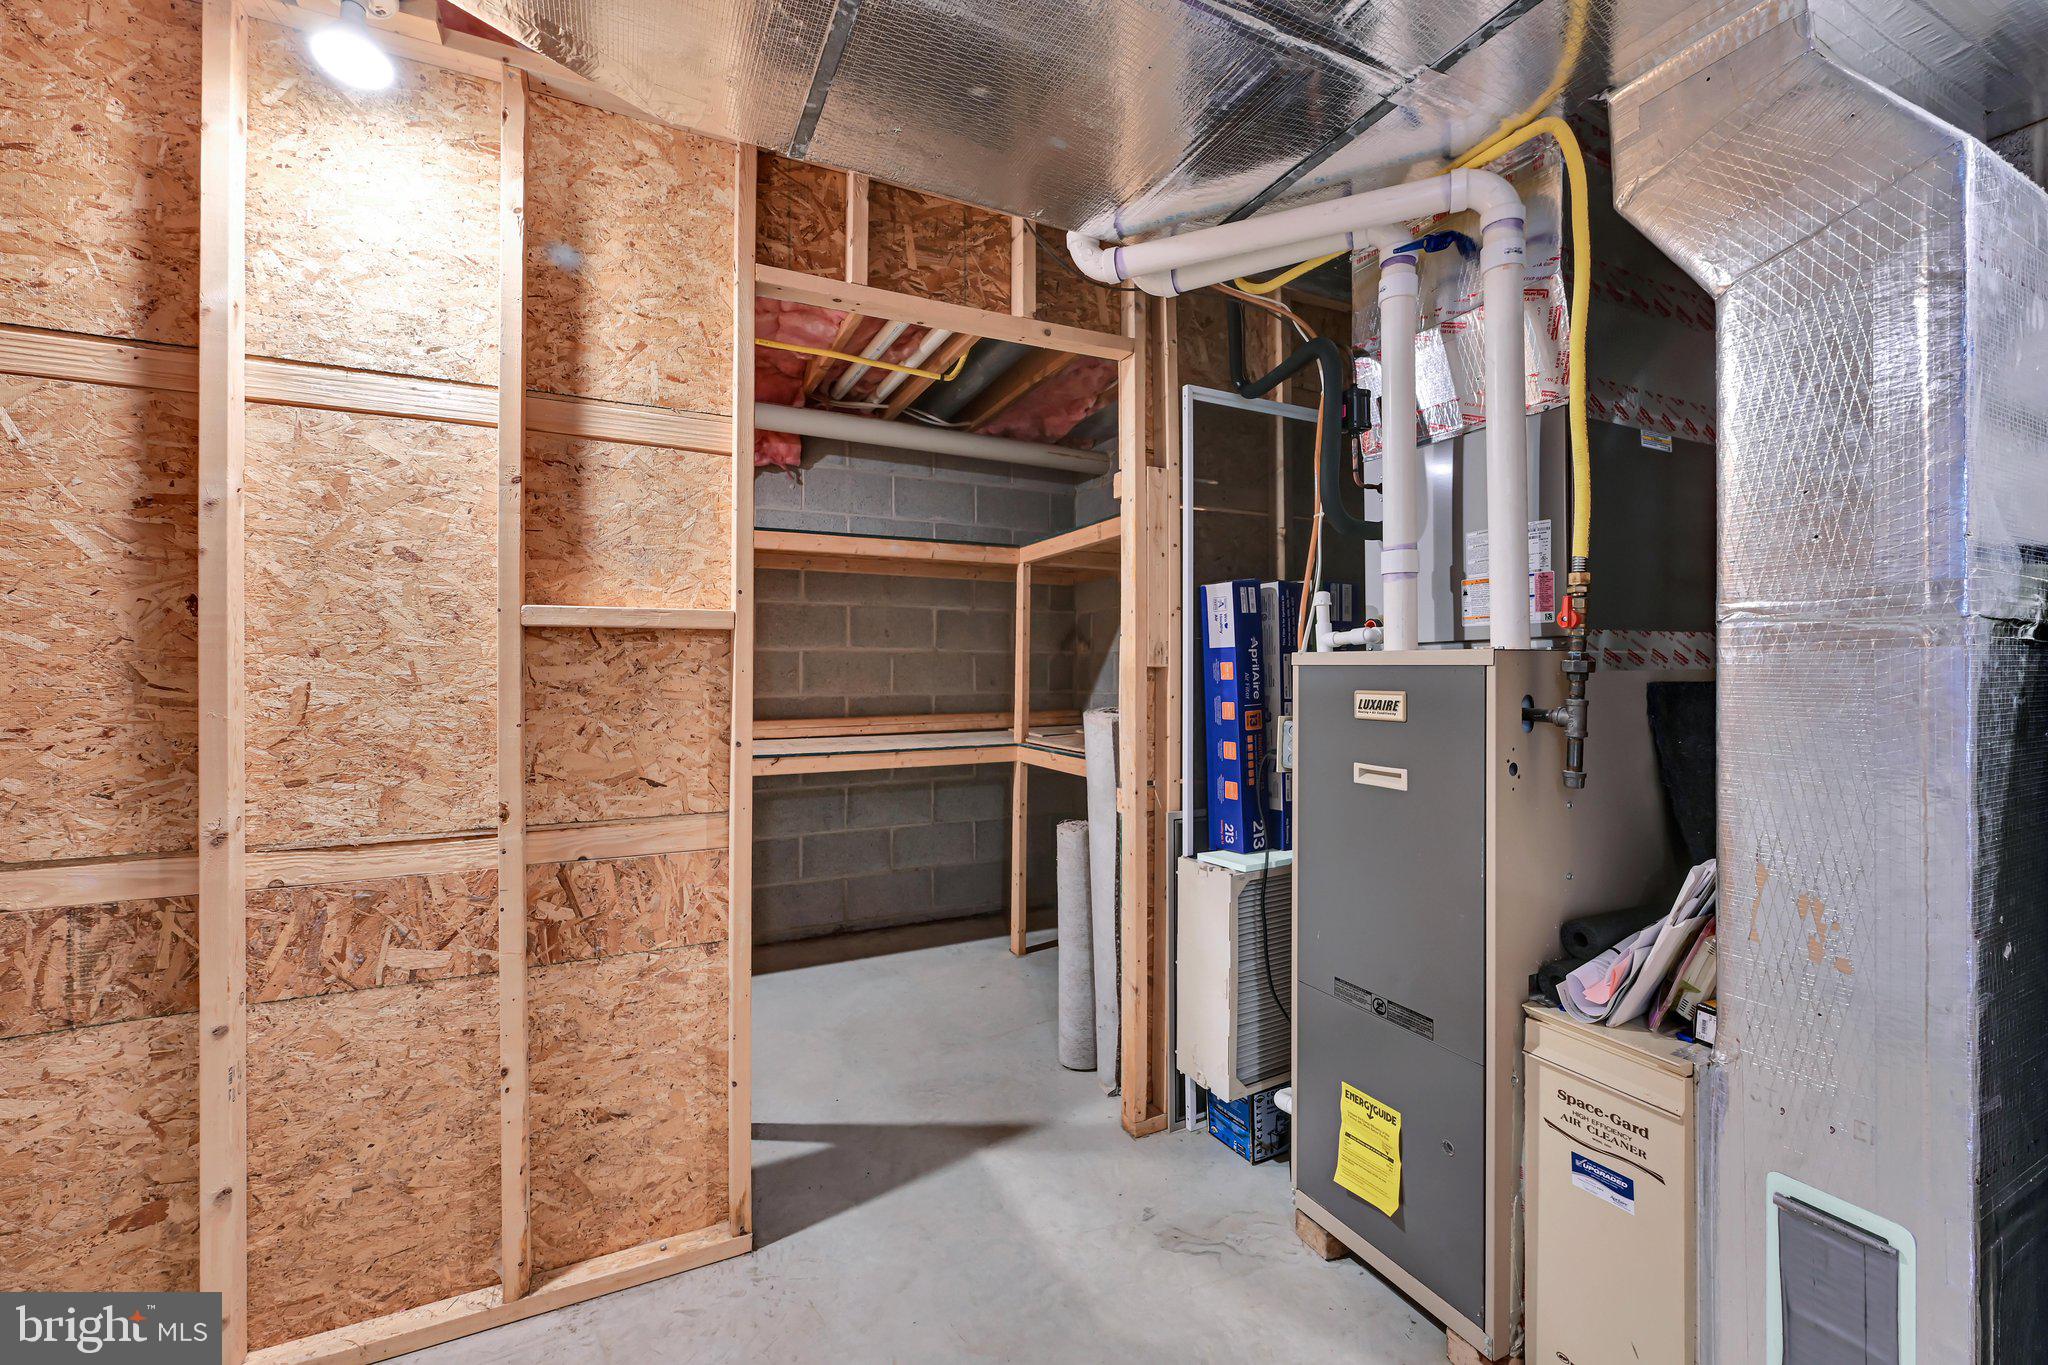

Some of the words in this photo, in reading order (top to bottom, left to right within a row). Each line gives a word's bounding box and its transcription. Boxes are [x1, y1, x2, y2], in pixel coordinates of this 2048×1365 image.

[1248, 636, 1261, 700] AprilAire
[1358, 698, 1400, 712] LUXAIRE
[1224, 823, 1235, 845] 213
[1252, 820, 1265, 850] 213
[1344, 1089, 1398, 1127] ENERGYGUIDE
[1557, 1089, 1650, 1141] Space-Gard
[1560, 1113, 1582, 1128] AIR
[1586, 1124, 1648, 1160] CLEANER
[1572, 1110, 1590, 1122] HIGH
[1591, 1119, 1633, 1142] EFFICIENCY
[1582, 1163, 1629, 1189] UPGRADED
